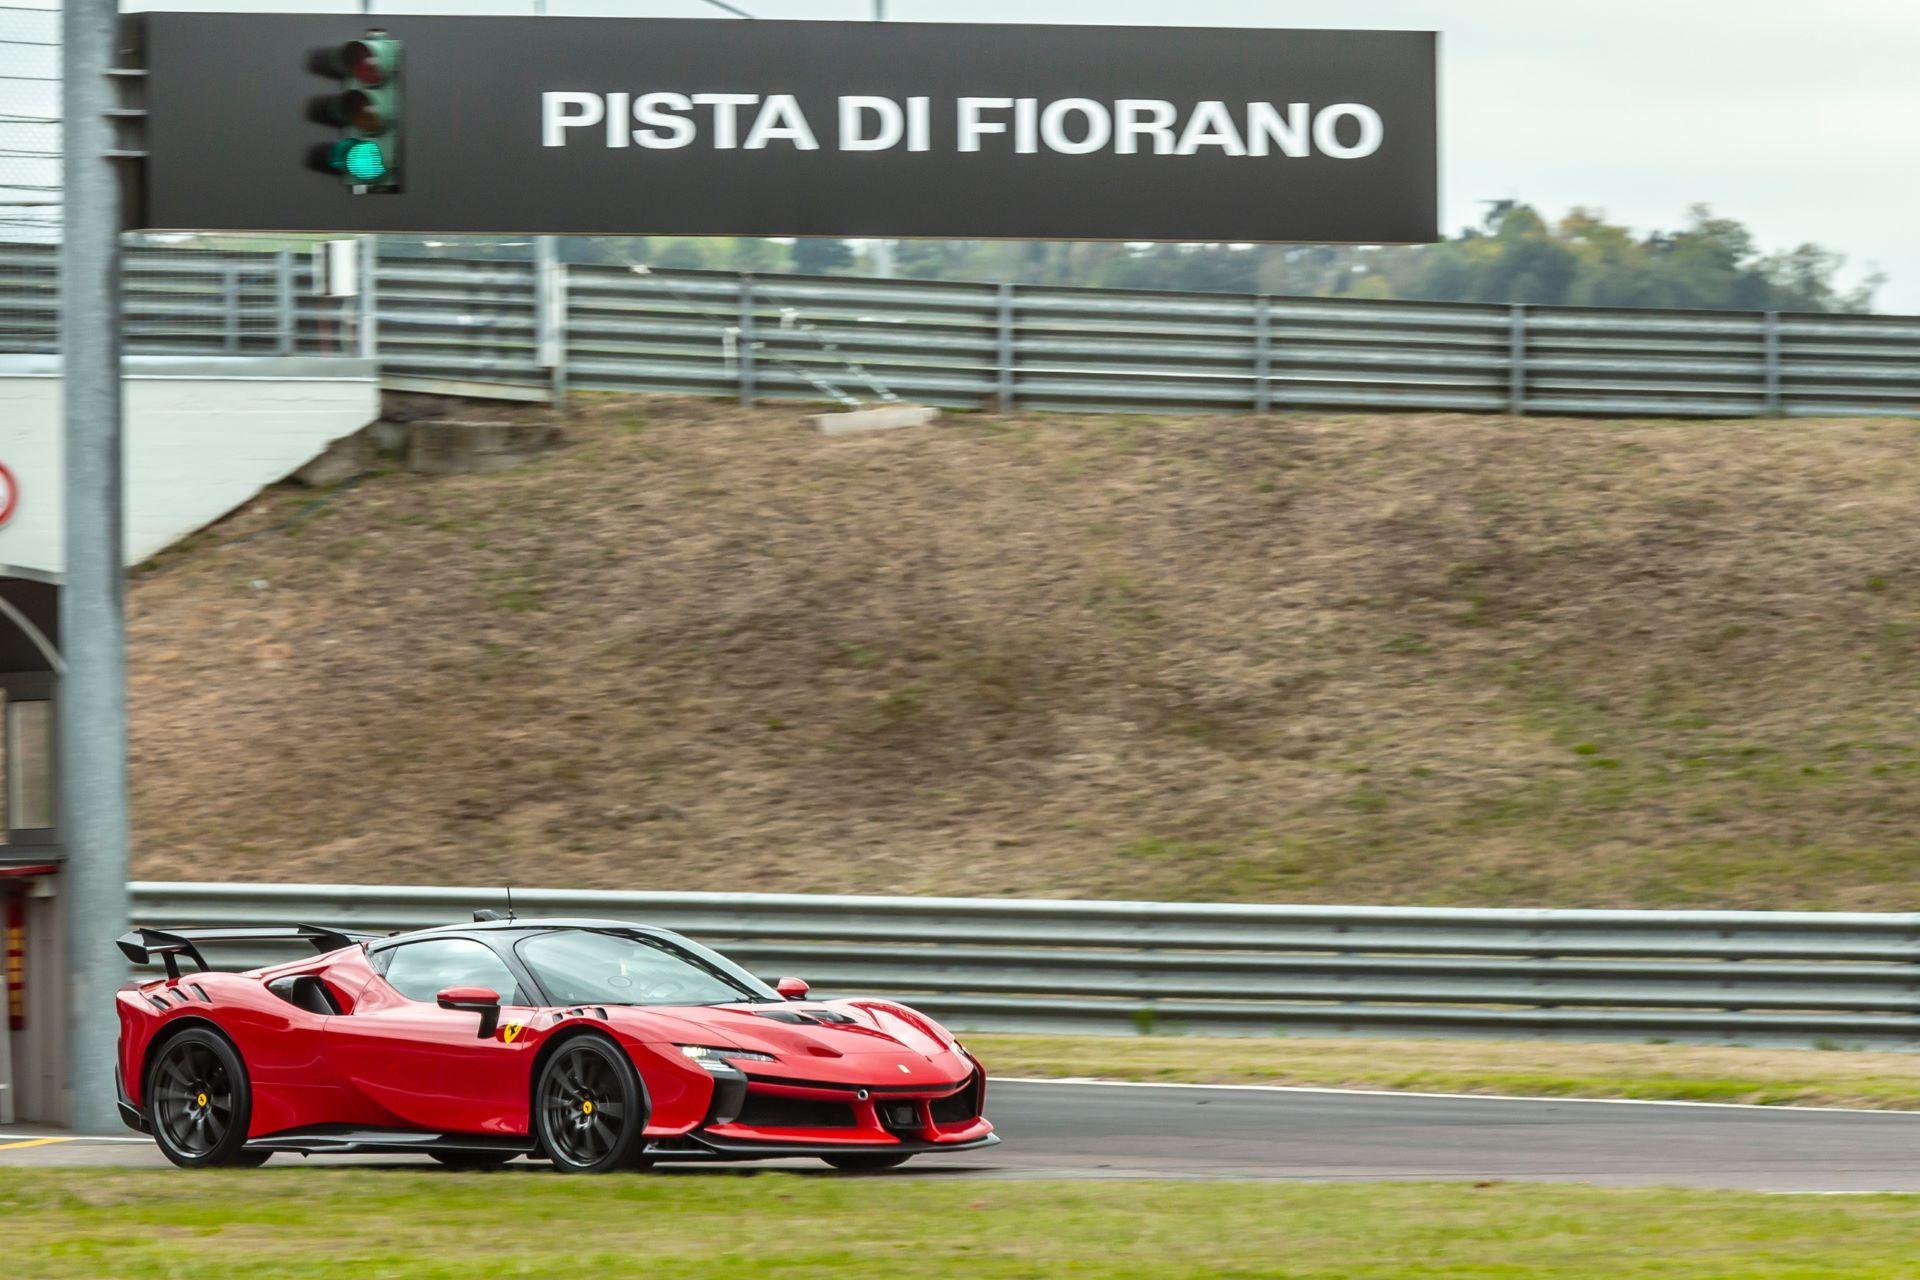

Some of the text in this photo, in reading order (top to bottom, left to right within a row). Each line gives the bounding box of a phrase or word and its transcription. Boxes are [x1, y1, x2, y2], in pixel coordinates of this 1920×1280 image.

[542, 91, 1384, 160] PISTA DI FIORANO
